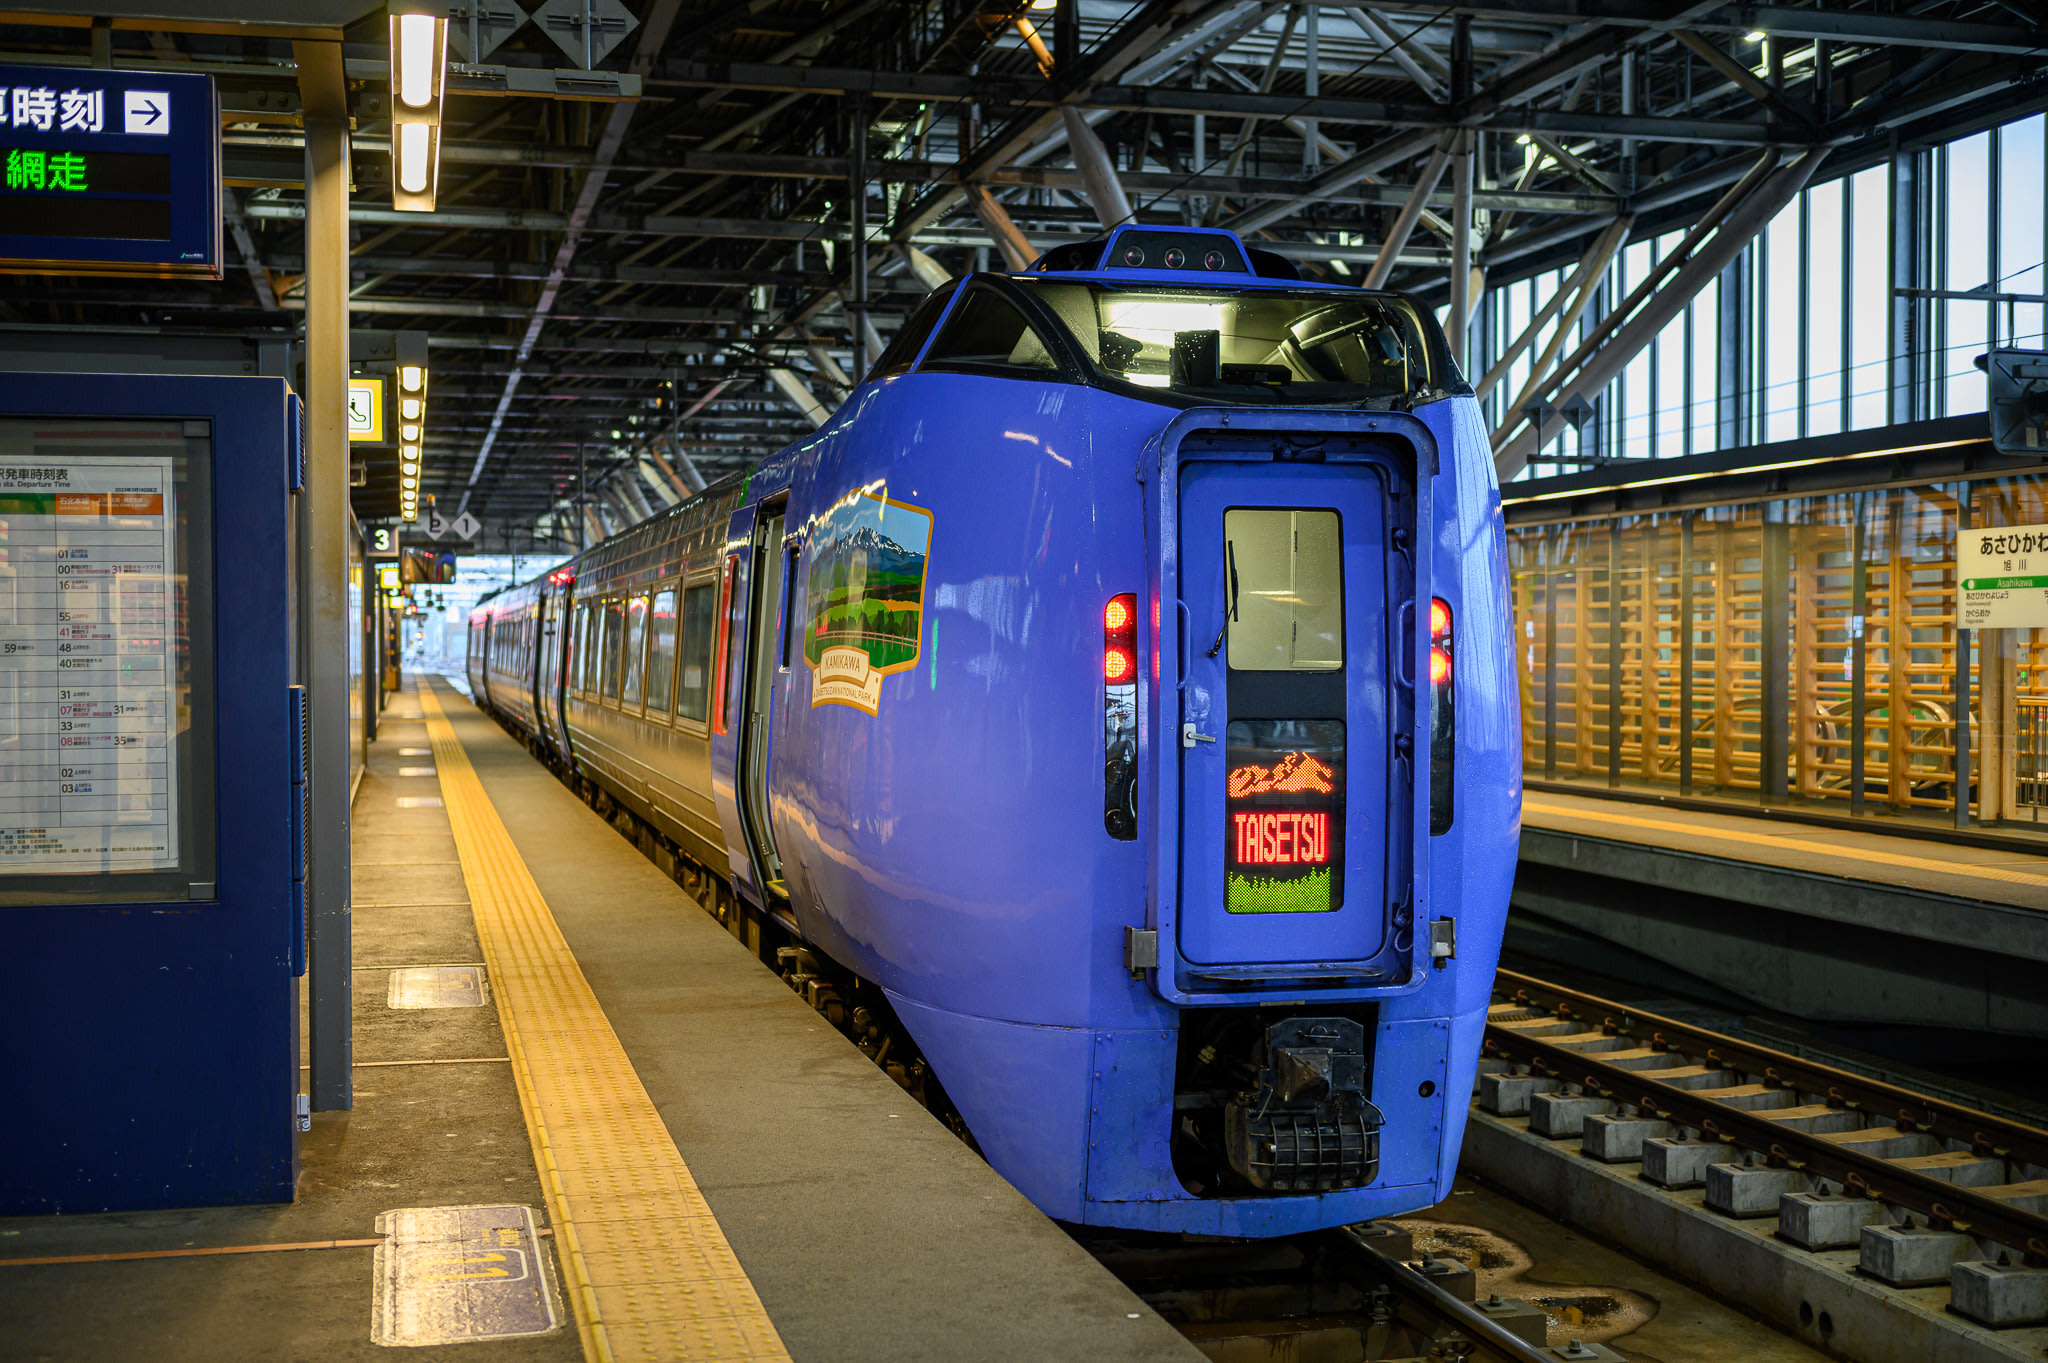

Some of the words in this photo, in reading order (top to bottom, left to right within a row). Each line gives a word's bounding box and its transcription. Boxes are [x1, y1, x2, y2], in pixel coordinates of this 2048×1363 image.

[0, 86, 104, 132] 時刻
[6, 149, 88, 191] 網走
[463, 518, 469, 533] 1
[374, 529, 390, 551] 3
[58, 550, 69, 559] 01
[58, 565, 70, 574] 00
[112, 565, 122, 574] 31
[2004, 559, 2026, 571] 旭川
[60, 581, 70, 590] 16
[1997, 579, 2033, 588] Asahikawa
[59, 612, 71, 621] 55
[59, 628, 70, 637] 41
[4, 644, 16, 653] 59
[59, 644, 71, 653] 48
[59, 659, 72, 668] 40
[825, 655, 860, 672] KAMIKAWA
[60, 691, 71, 699] 31
[858, 690, 872, 702] PARK
[60, 706, 72, 715] 07
[114, 705, 124, 714] 31
[60, 722, 73, 730] 33
[60, 737, 73, 746] 08
[114, 736, 126, 745] 35
[62, 769, 74, 777] 02
[62, 784, 73, 793] 03
[1234, 813, 1326, 863] TAISETSU
